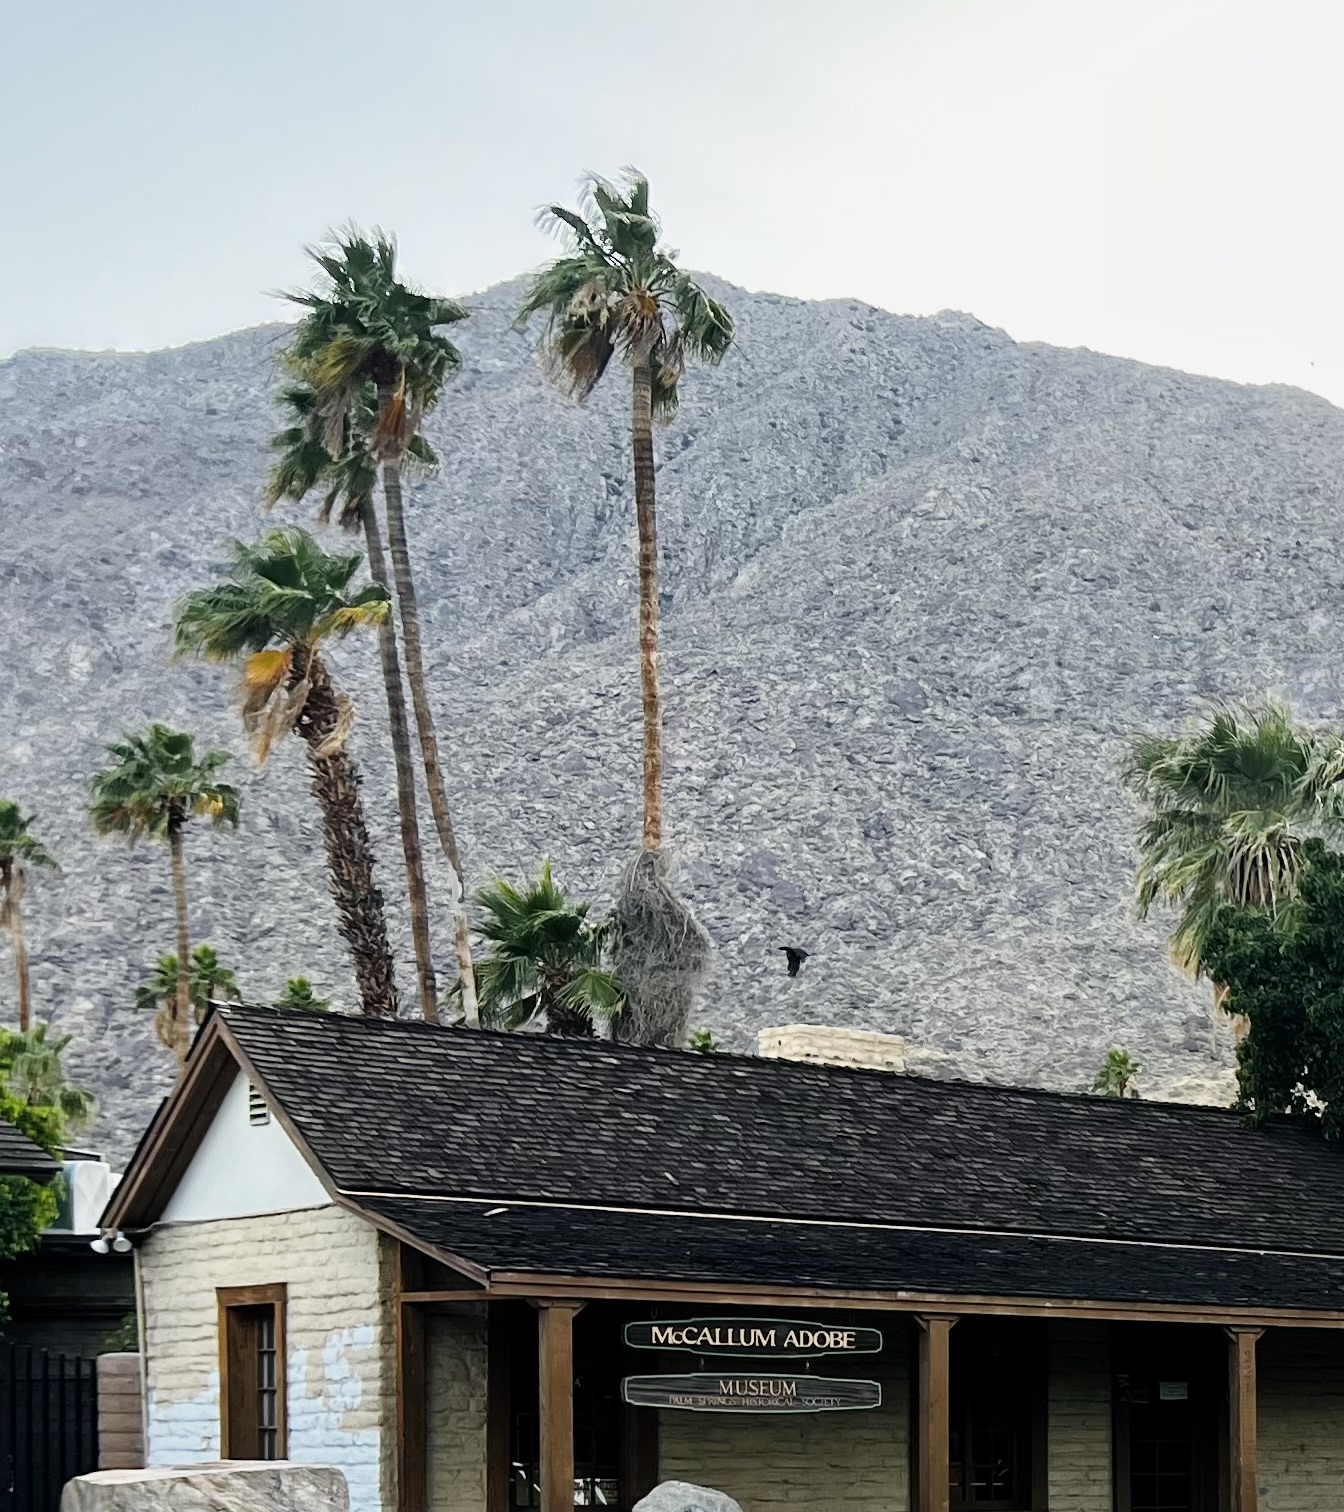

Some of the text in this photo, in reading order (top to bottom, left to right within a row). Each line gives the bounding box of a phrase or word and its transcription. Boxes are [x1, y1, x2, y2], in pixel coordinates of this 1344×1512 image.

[651, 1326, 856, 1349] McCALLUM ADOBE
[719, 1380, 797, 1396] MUSEUM
[697, 1397, 736, 1406] SPRINGS
[742, 1397, 796, 1406] HISTORICAL
[800, 1397, 842, 1407] SOCIETY
